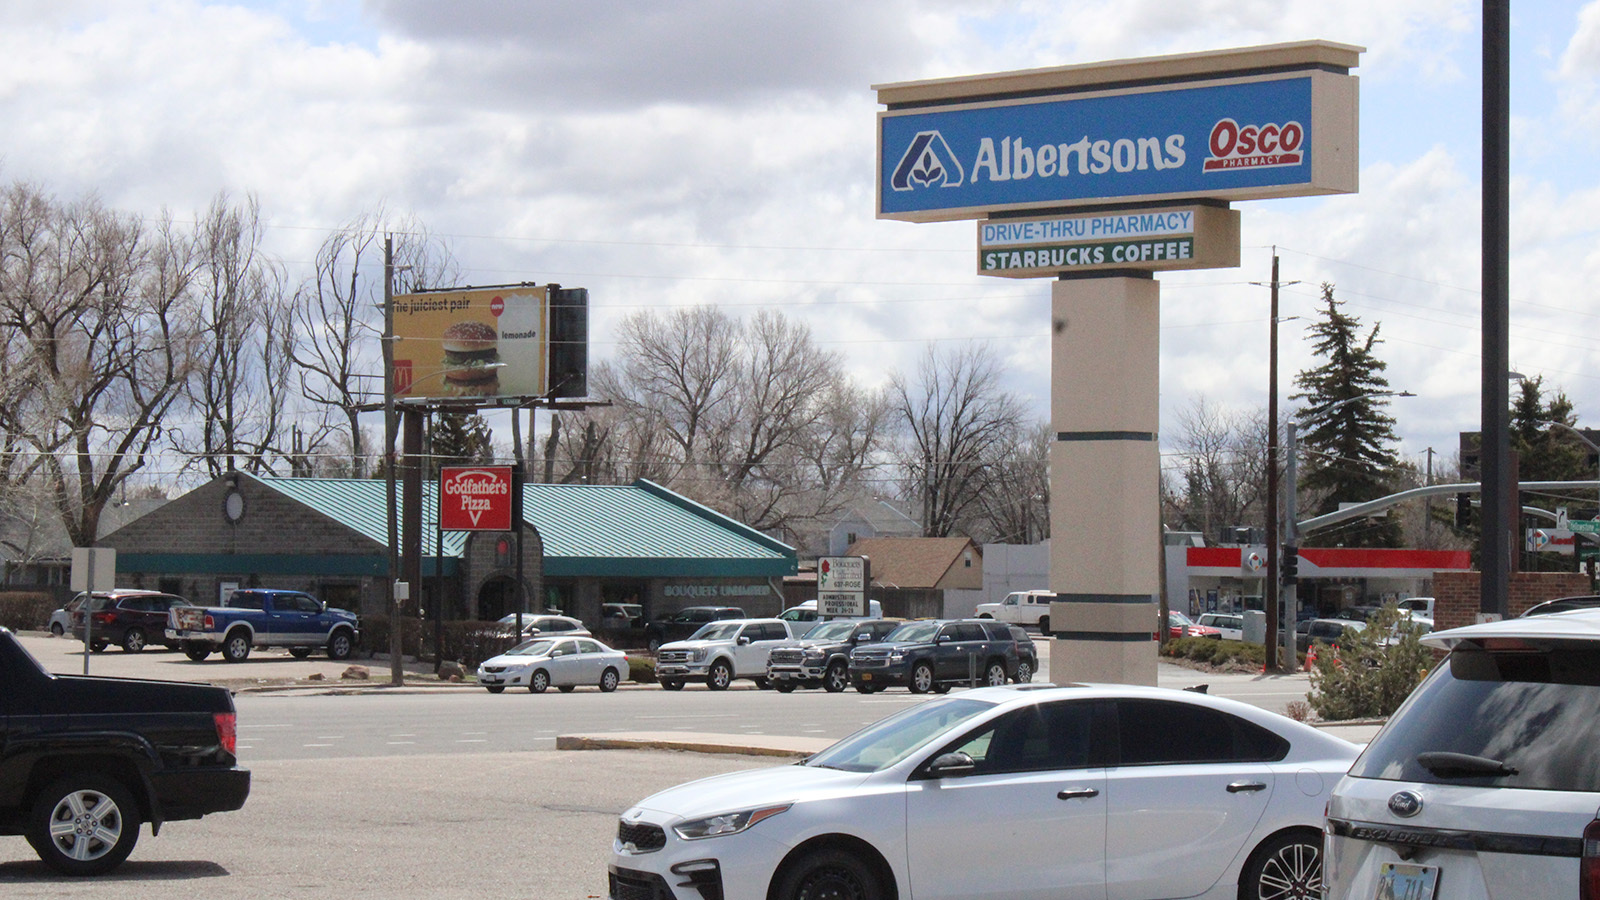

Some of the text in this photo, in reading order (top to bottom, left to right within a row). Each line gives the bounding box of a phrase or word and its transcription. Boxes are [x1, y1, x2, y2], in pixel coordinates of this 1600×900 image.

[1208, 117, 1304, 159] Osco
[970, 133, 1187, 184] Albertsons
[1222, 154, 1281, 168] PHARMACY
[983, 211, 1192, 243] DRIVE-THRU PHARMACY
[985, 241, 1191, 271] STARBUCKS COFFEE
[409, 297, 448, 316] juiciest
[450, 296, 471, 313] pair
[501, 330, 536, 340] lemonade
[445, 478, 507, 494] Godfather's
[461, 495, 491, 511] Pizza
[832, 559, 861, 570] Bouquets
[664, 584, 718, 598] BOUQUETS
[1393, 794, 1411, 811] Ford
